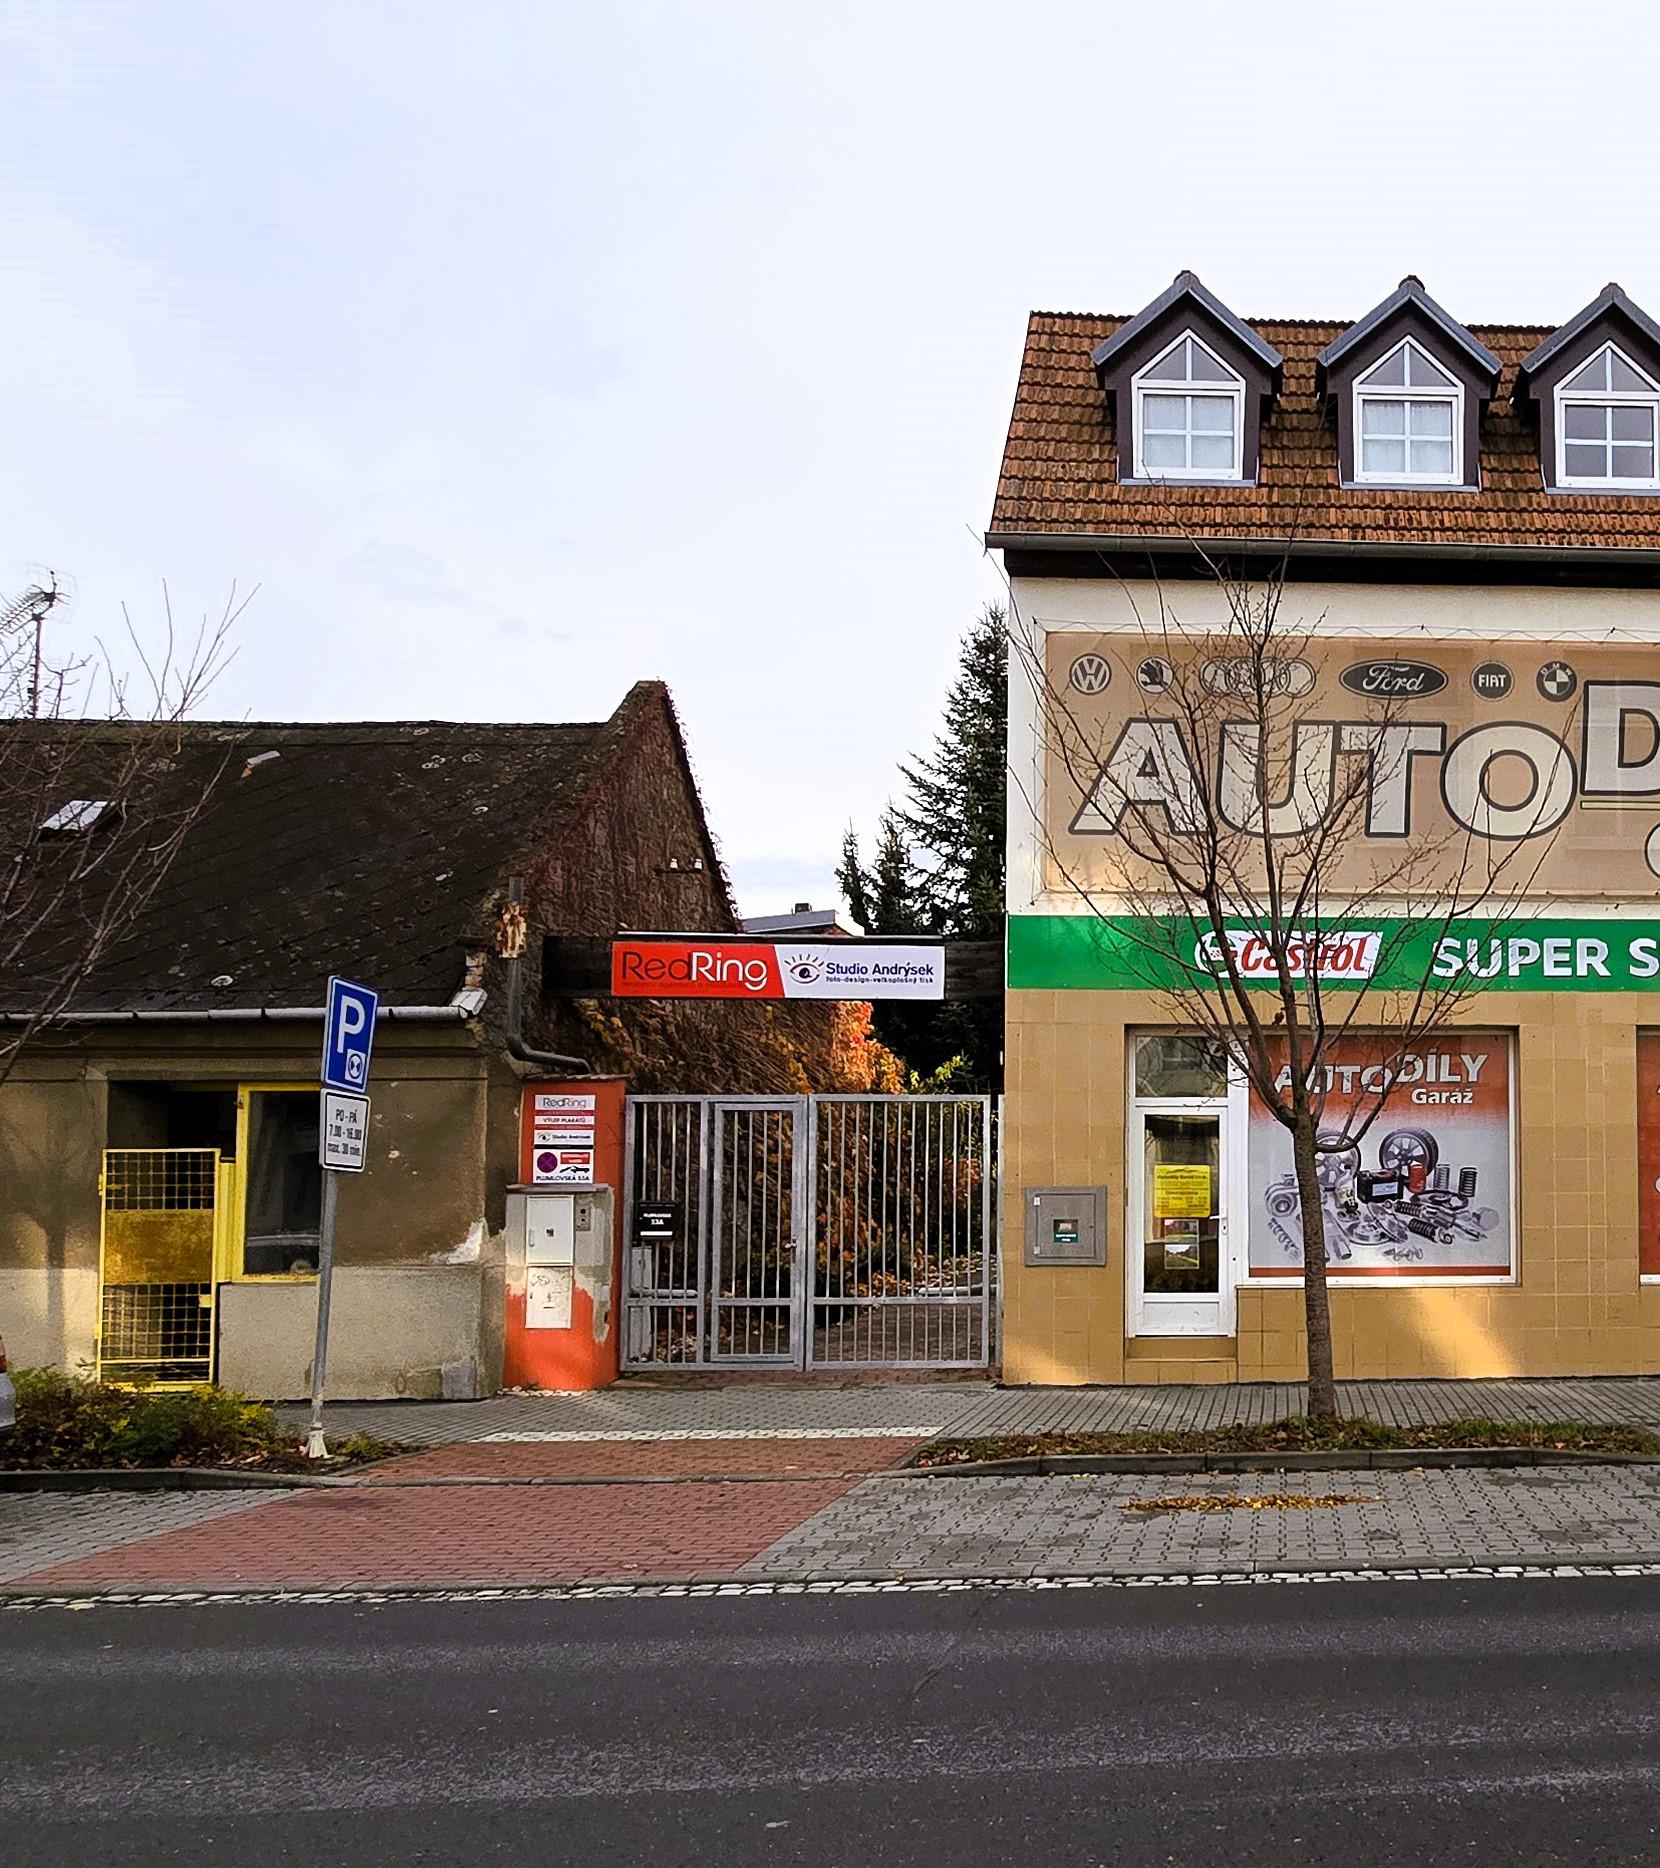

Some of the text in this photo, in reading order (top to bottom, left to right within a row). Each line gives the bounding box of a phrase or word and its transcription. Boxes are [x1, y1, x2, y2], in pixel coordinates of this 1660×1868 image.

[1362, 664, 1424, 692] Ford
[1478, 674, 1507, 688] FIAT
[1241, 937, 1367, 971] Castrol
[1431, 938, 1612, 978] SUPER
[621, 951, 768, 991] RedRing
[826, 962, 934, 977] Studio Andrýsek
[337, 994, 365, 1054] P
[1411, 1087, 1474, 1104] Garáž
[335, 1108, 344, 1121] PO
[349, 1109, 358, 1123] PÁ
